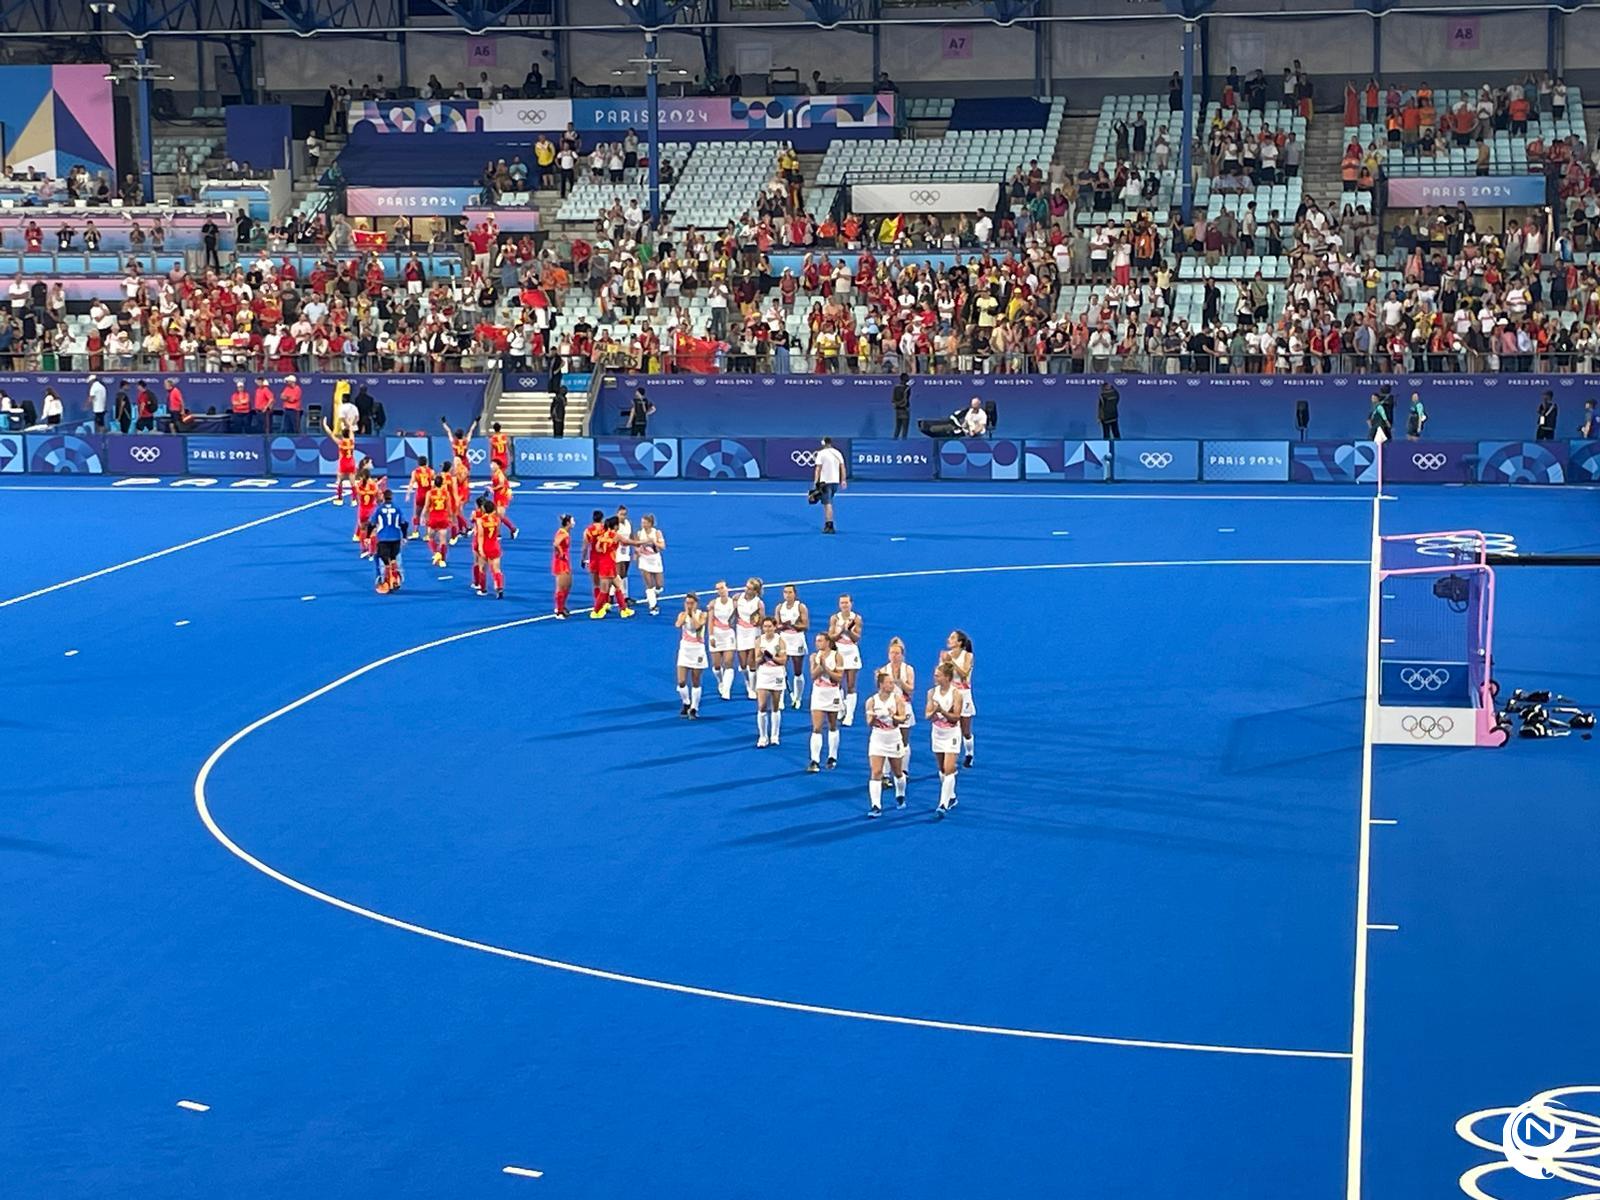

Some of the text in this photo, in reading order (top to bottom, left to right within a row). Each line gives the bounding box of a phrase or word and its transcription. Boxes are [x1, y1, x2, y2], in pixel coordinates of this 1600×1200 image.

[1455, 28, 1473, 39] A8
[949, 38, 966, 49] A7
[474, 46, 490, 57] A6
[594, 109, 708, 123] PARIS 2024
[1422, 186, 1511, 197] PARIS 2024
[377, 196, 456, 207] PARIS 2024
[193, 450, 258, 460] PARIS 2024
[521, 453, 588, 462] PARIS 2024
[858, 454, 928, 464] PARIS 2024
[1210, 456, 1282, 465] PARIS 2024
[488, 527, 495, 539] 7
